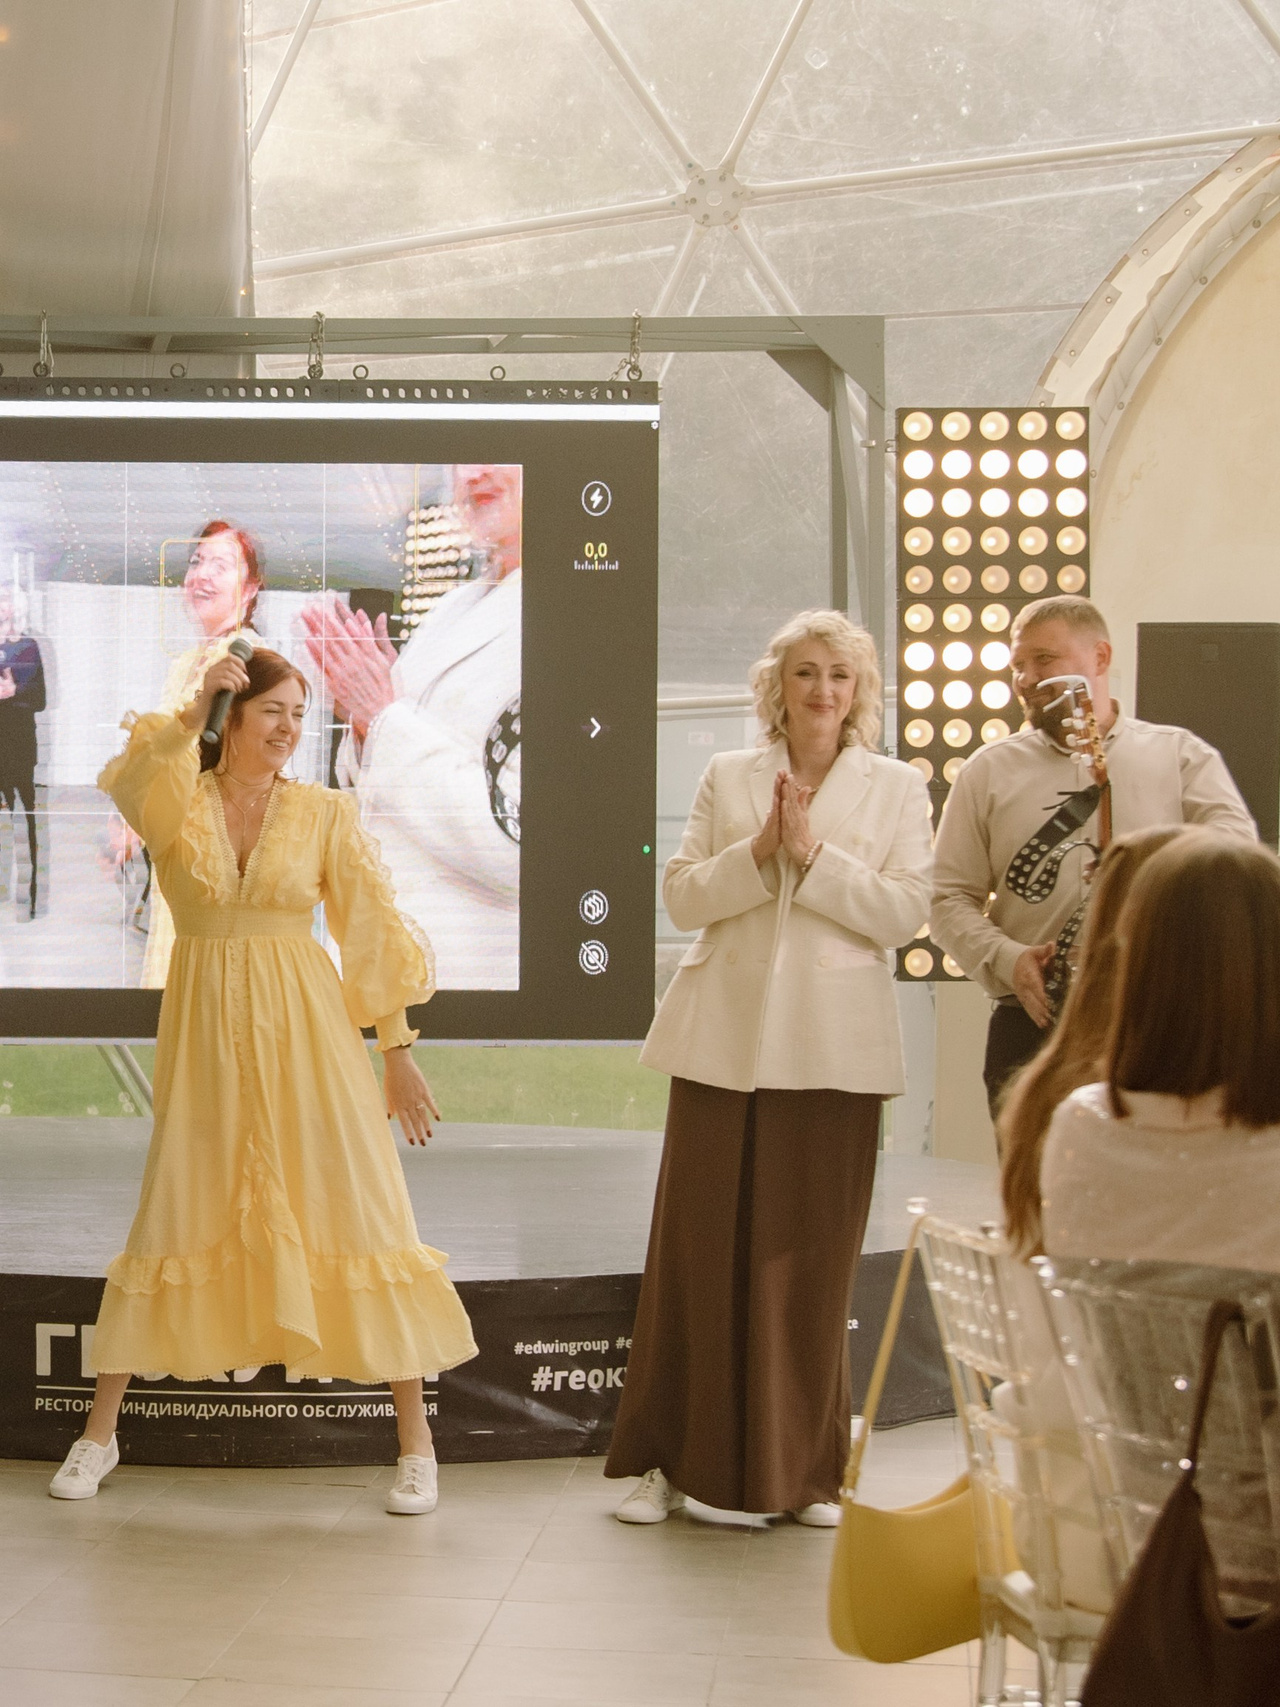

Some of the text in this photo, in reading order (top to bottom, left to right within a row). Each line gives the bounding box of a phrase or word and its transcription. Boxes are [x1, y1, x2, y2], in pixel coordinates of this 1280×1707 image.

[584, 542, 608, 560] 0,0
[514, 1339, 610, 1356] #edwingroup
[35, 1397, 94, 1413] РЕСТОР
[121, 1401, 298, 1420] ИНДИВИДУАЛЬНОГО
